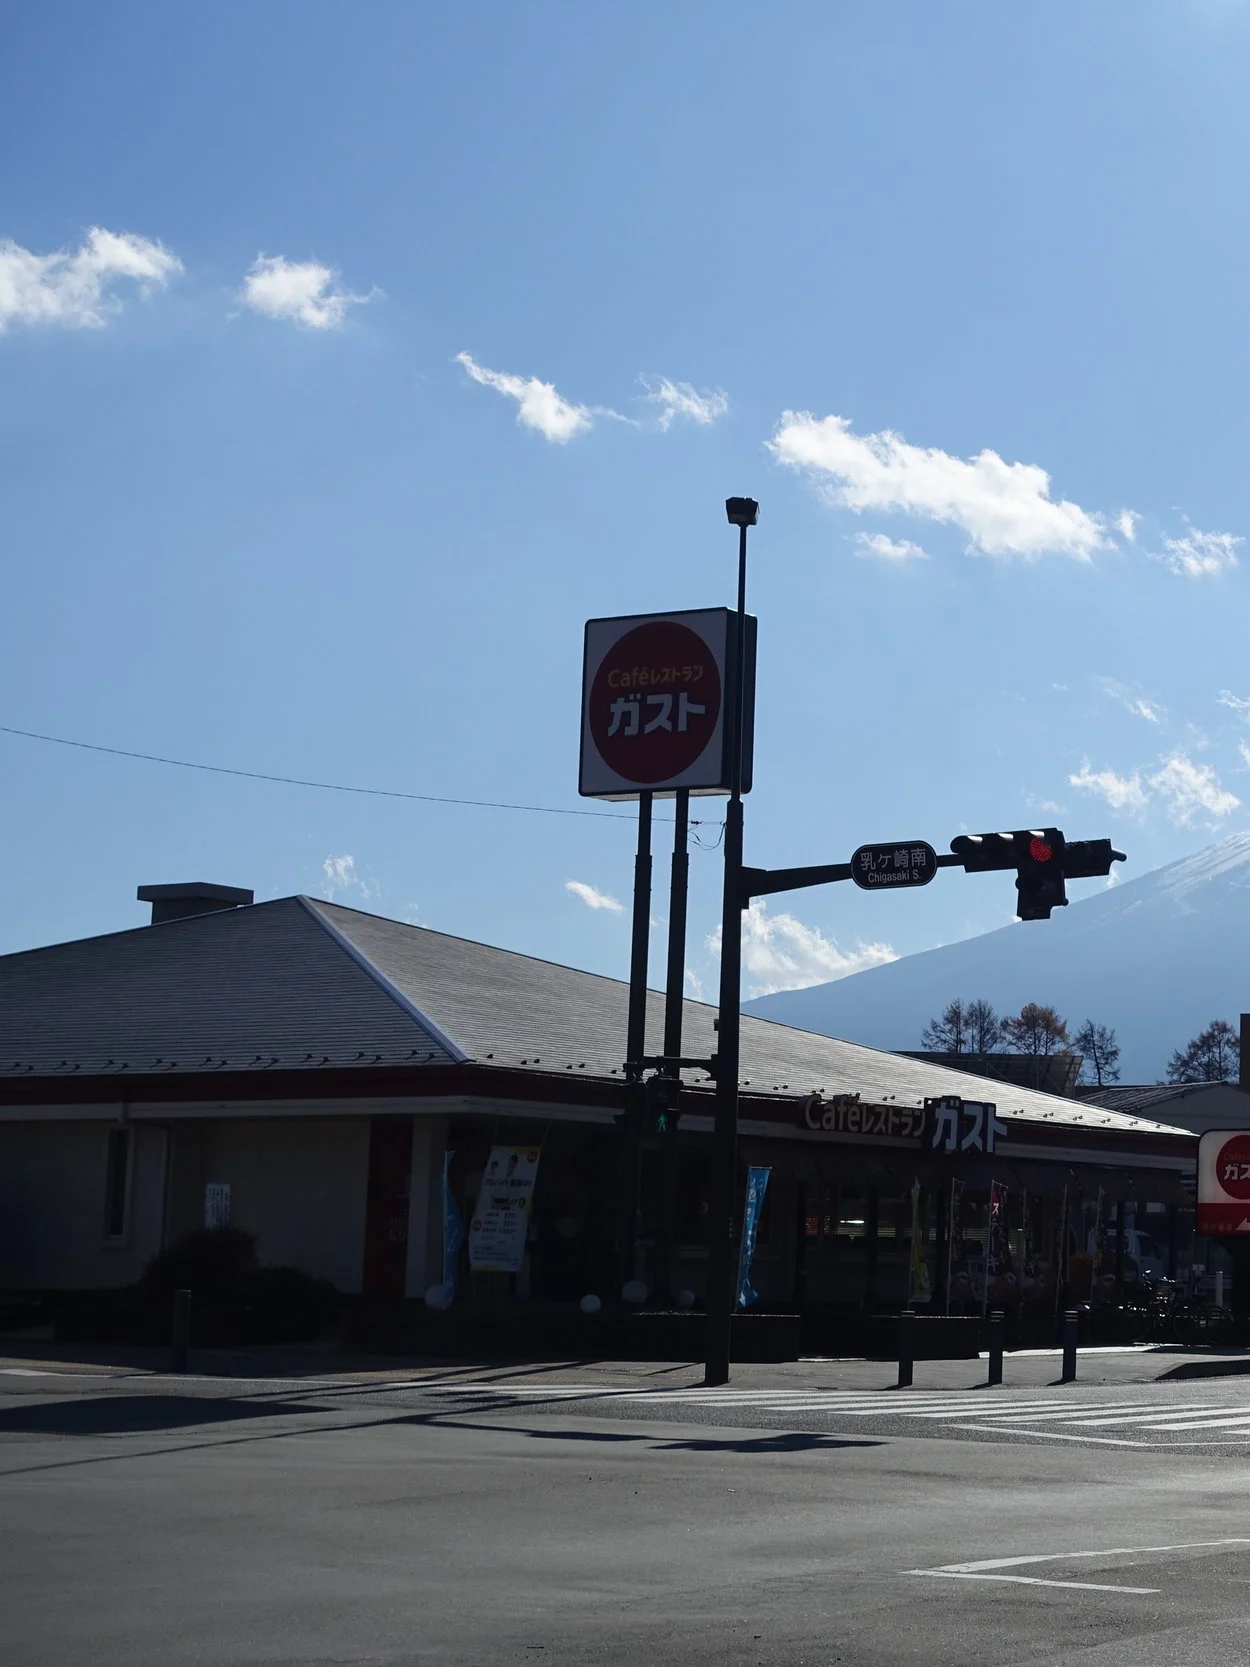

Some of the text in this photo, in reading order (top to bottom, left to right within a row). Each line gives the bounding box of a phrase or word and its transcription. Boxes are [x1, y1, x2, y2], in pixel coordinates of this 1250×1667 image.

[607, 692, 706, 737] ガスト
[867, 869, 910, 883] Chigasaki
[932, 1101, 1008, 1153] ガスト
